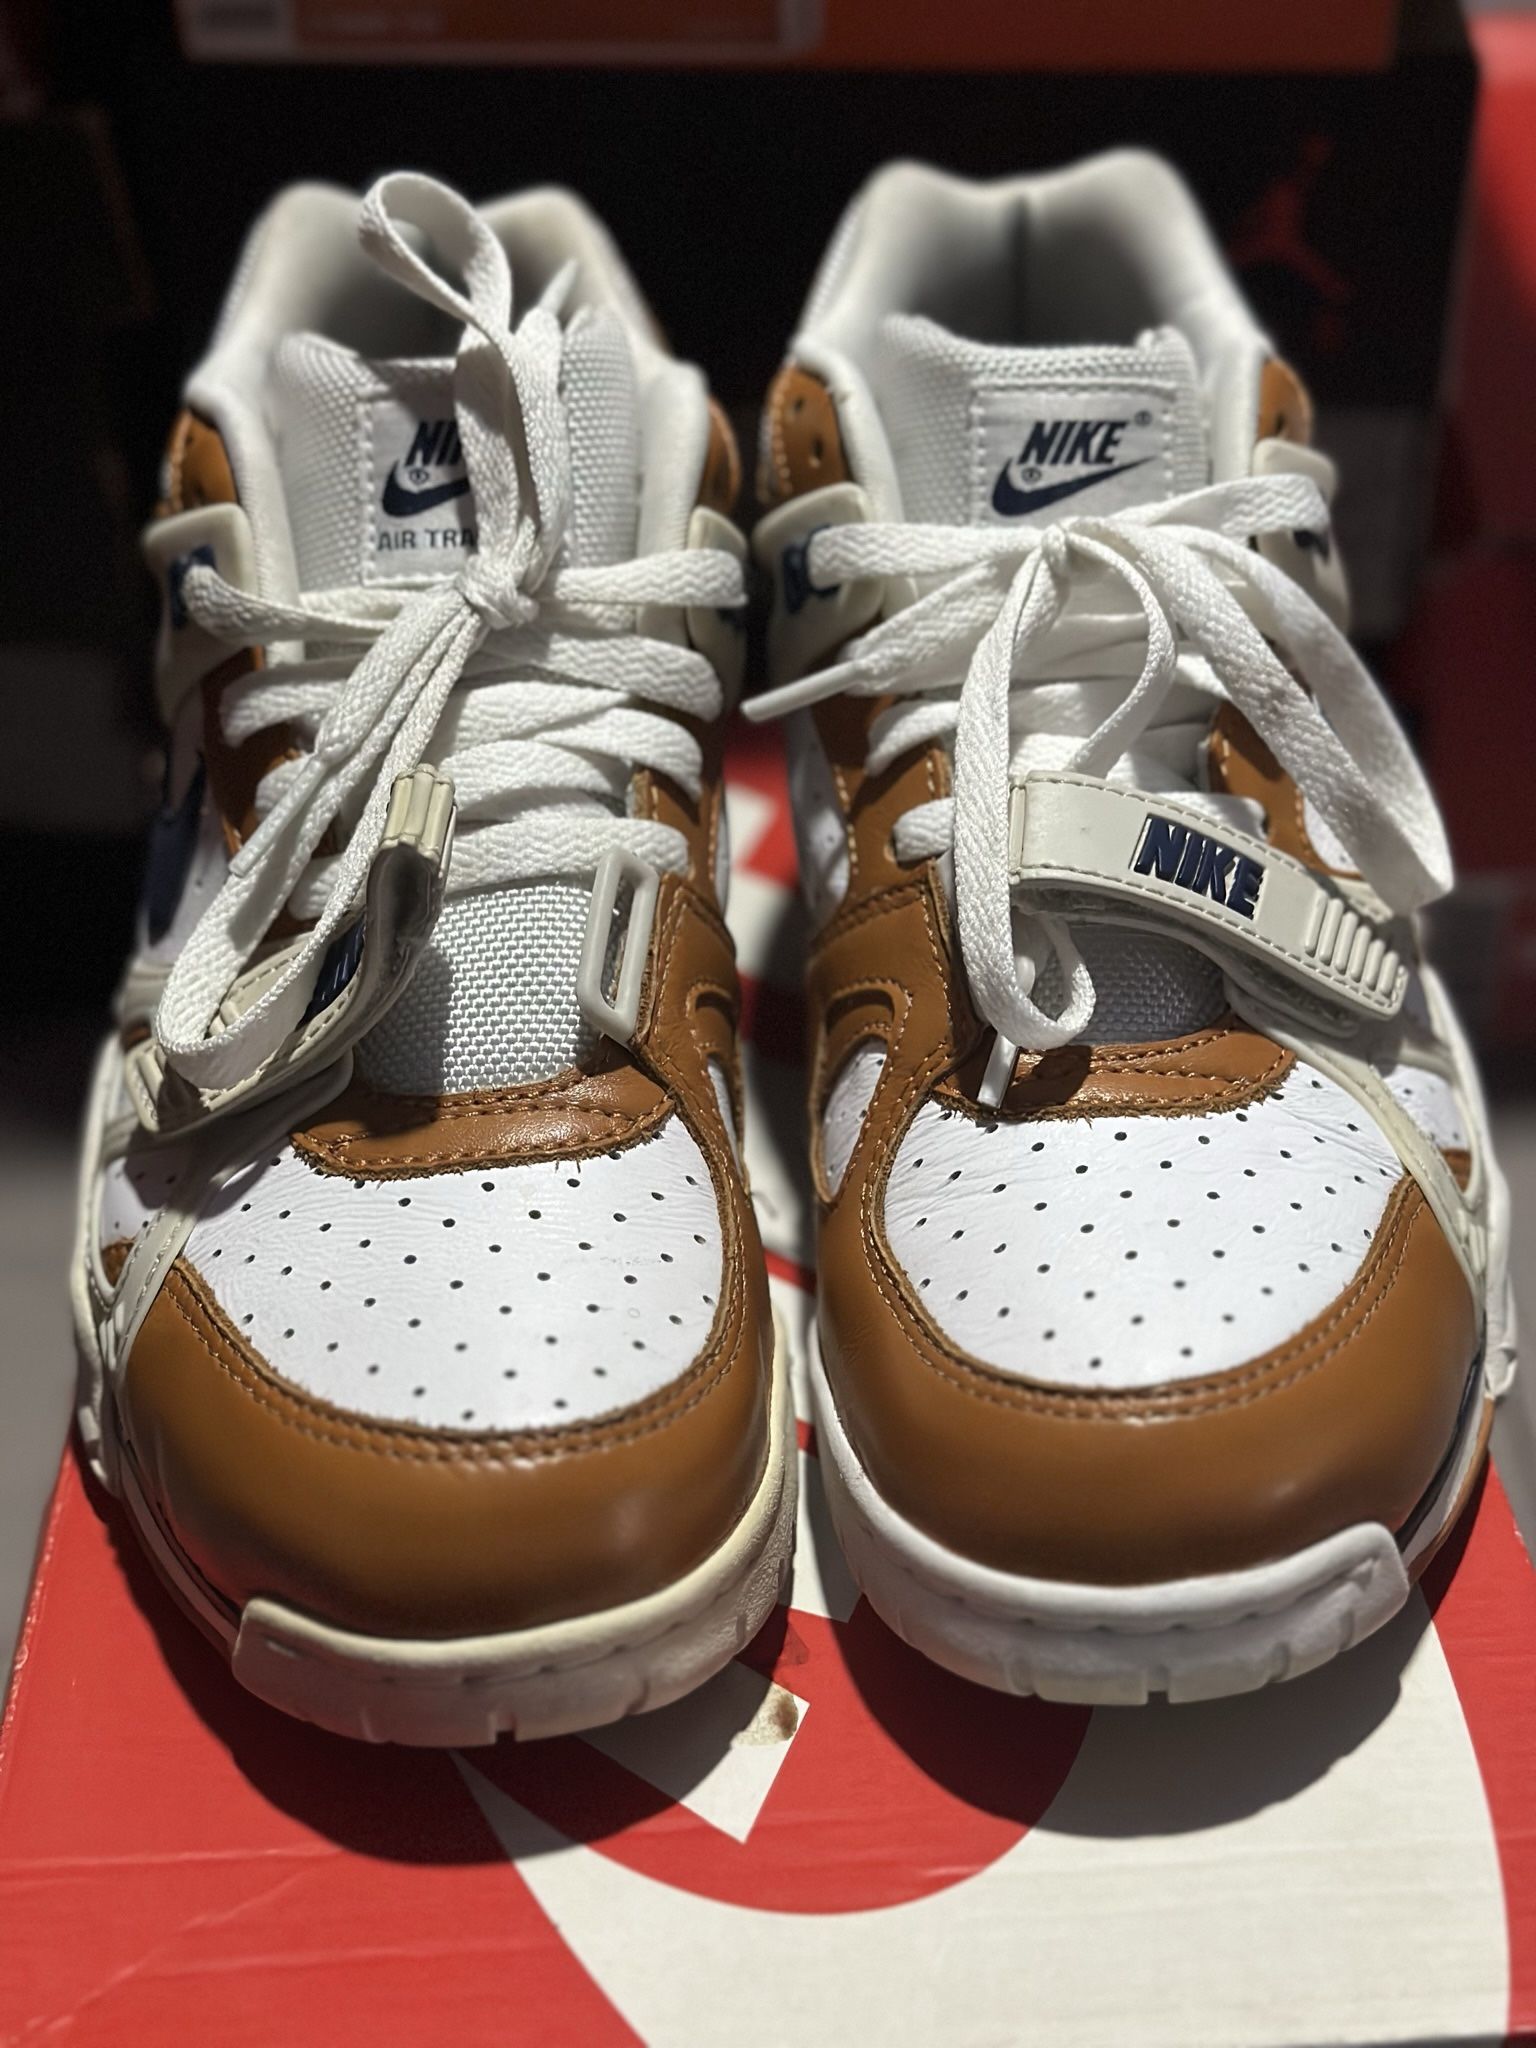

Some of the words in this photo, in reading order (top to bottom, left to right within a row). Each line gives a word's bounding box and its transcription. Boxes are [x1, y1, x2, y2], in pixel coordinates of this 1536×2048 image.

[1018, 420, 1130, 466] NIKE
[377, 529, 417, 551] AIR
[1133, 814, 1267, 922] NIKE
